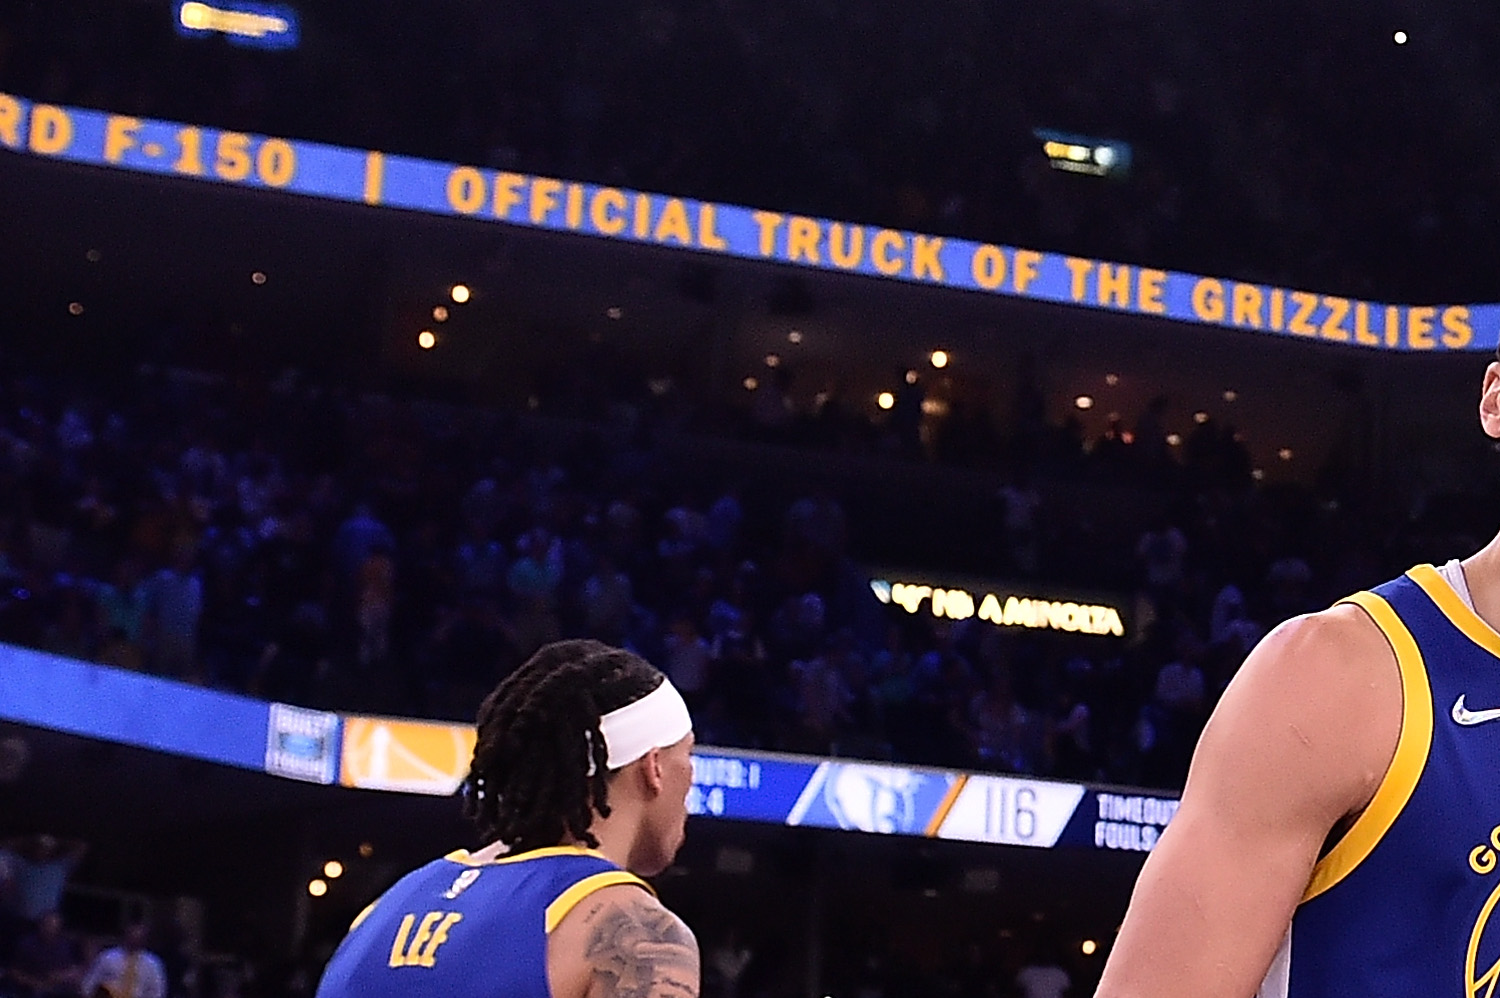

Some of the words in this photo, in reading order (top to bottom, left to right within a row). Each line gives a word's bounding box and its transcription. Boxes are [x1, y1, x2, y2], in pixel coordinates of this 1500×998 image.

[103, 114, 295, 188] F-150
[446, 166, 727, 251] OFFICIAL
[753, 211, 945, 281] TRUCK
[971, 244, 1042, 294] OF
[1065, 257, 1167, 313] THE
[1192, 277, 1473, 348] GRIZZLIES
[984, 786, 1036, 840] 116
[389, 911, 463, 968] LEE
